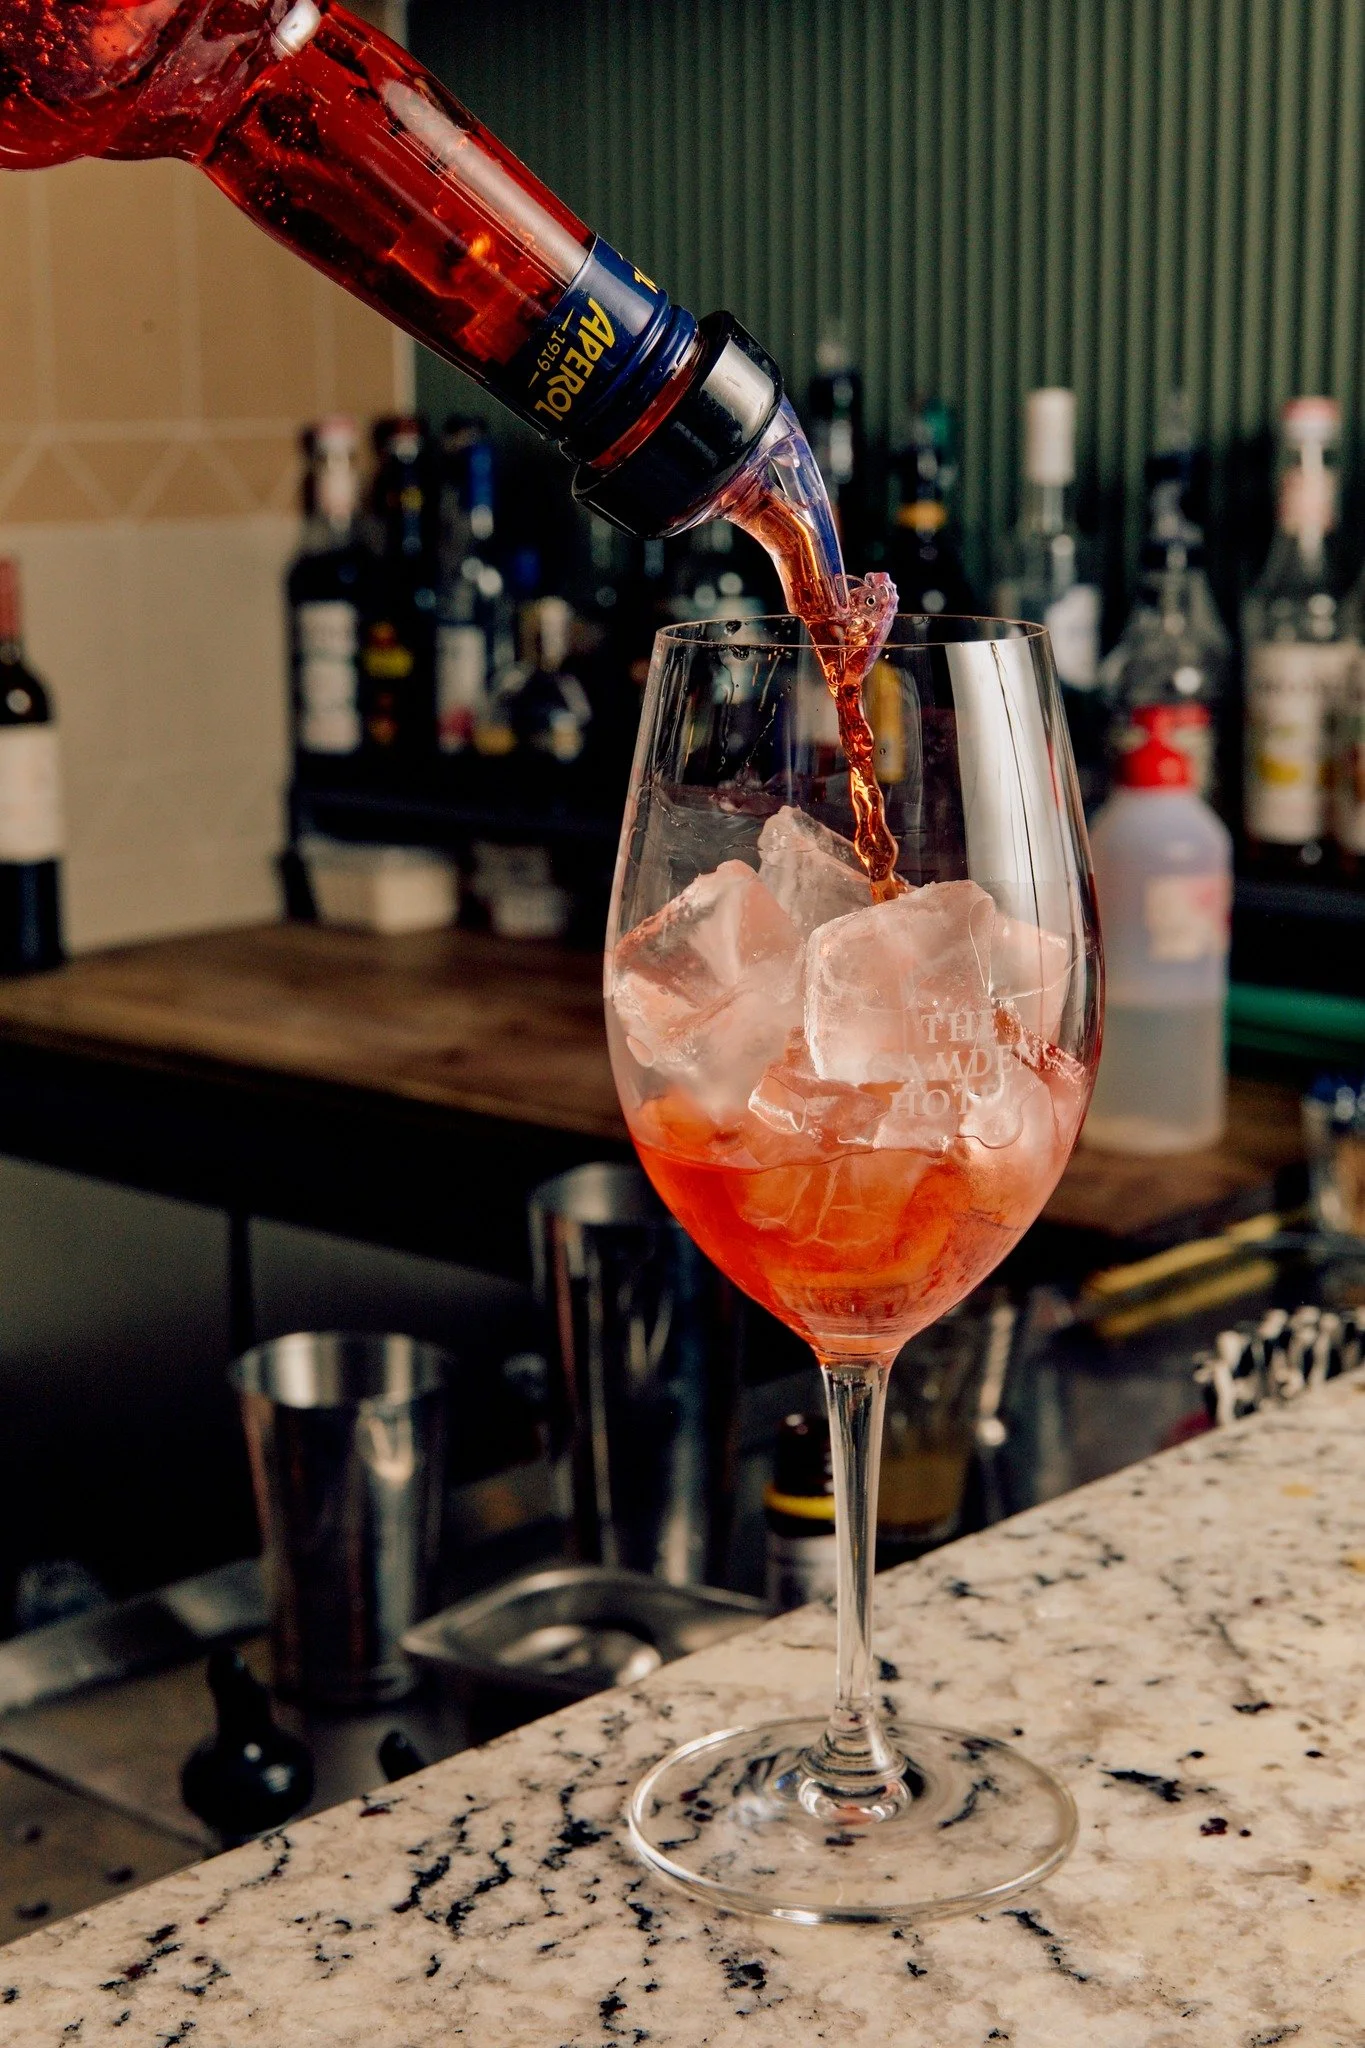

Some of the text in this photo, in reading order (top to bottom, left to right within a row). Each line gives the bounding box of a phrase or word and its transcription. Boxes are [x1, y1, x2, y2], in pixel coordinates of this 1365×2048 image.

[534, 297, 616, 422] APEROL
[536, 330, 567, 373] 1919
[920, 1008, 999, 1044] THE
